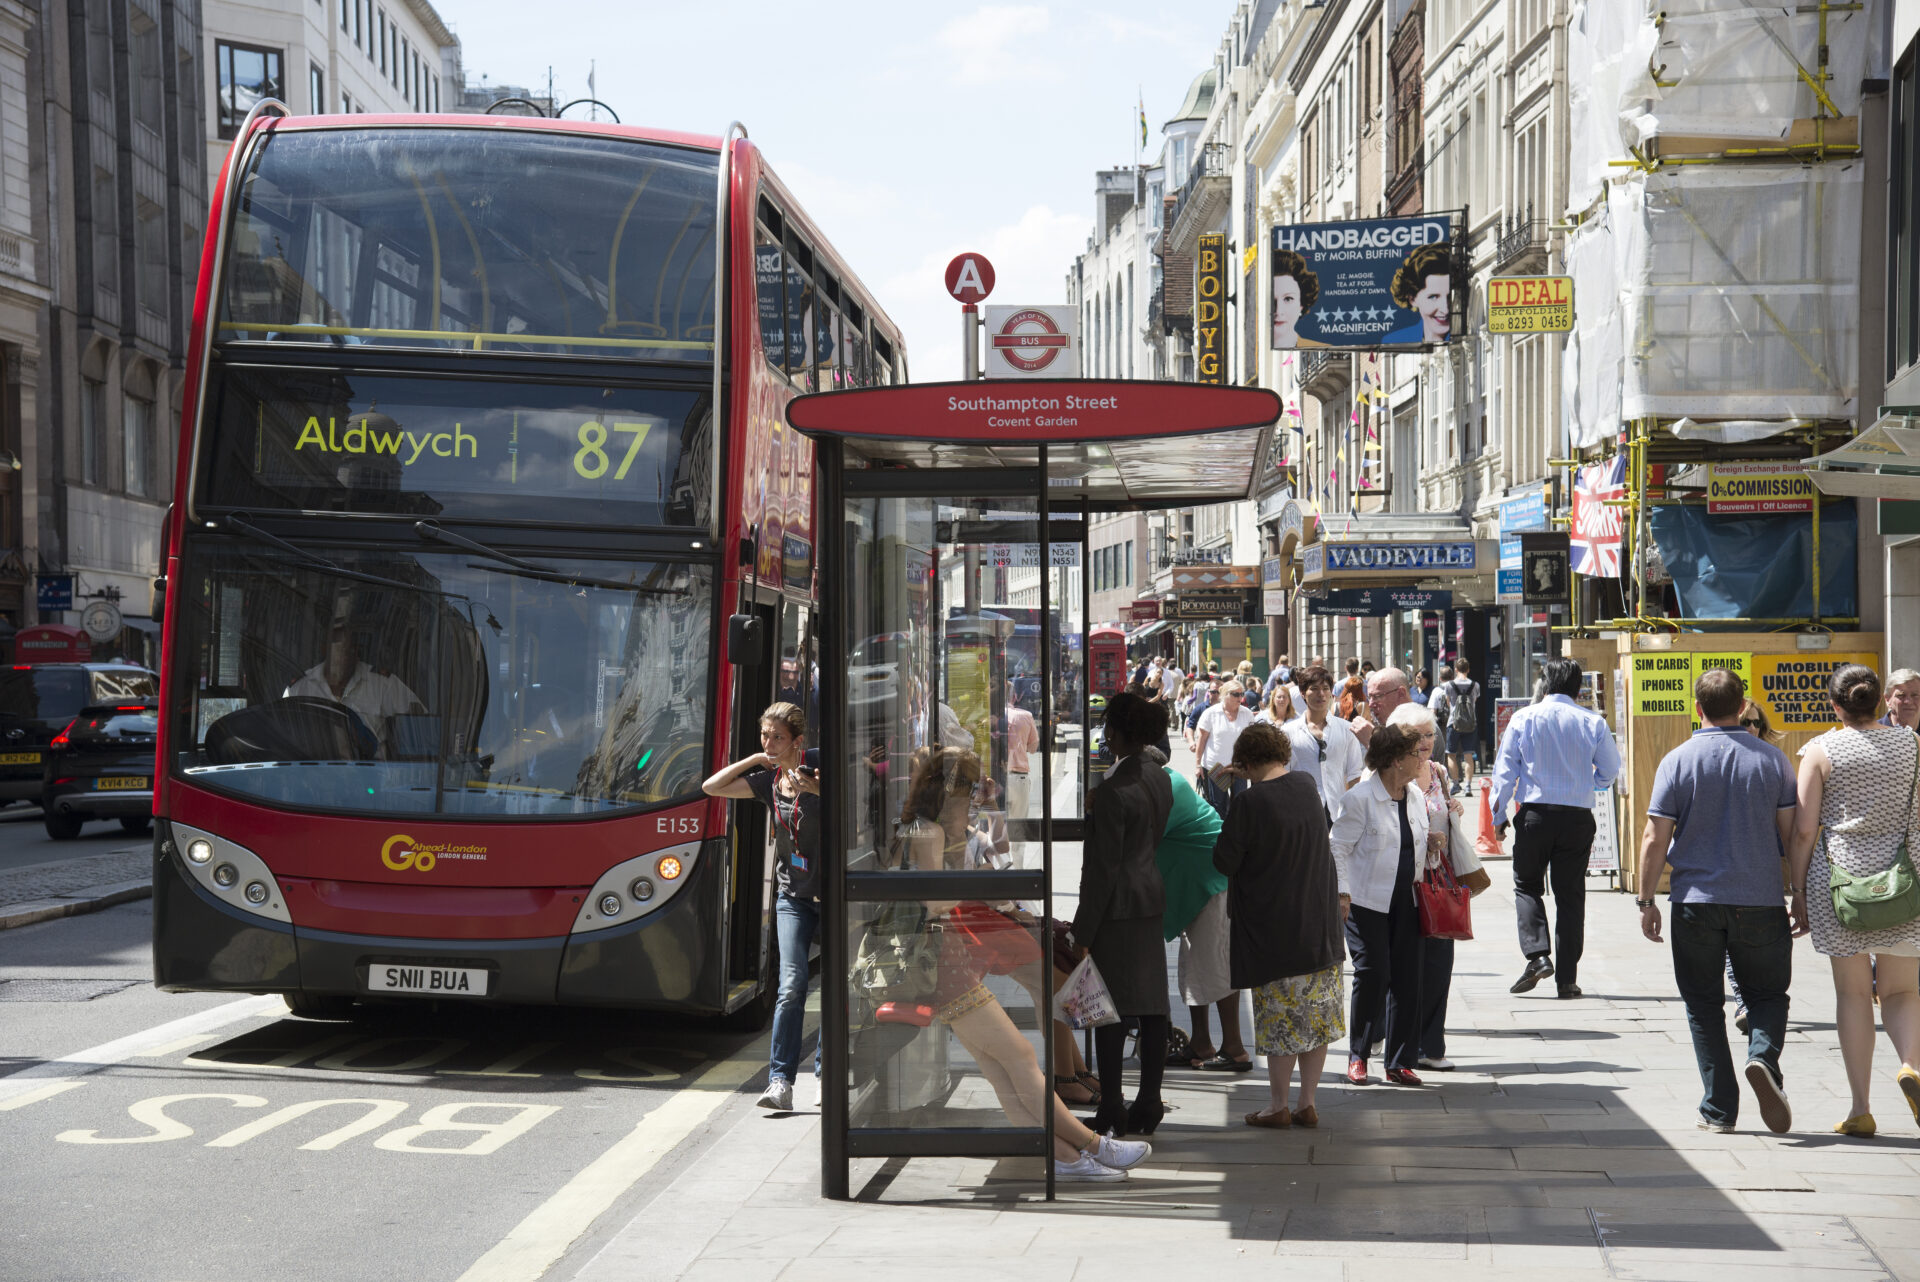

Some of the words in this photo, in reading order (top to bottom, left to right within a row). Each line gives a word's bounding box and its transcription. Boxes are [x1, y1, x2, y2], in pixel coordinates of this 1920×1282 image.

[1201, 238, 1220, 246] THE
[1277, 222, 1444, 251] HANDBAGGED
[1314, 252, 1327, 262] BY
[1329, 250, 1363, 261] MOIRA
[1365, 248, 1402, 259] BUFFINI
[953, 259, 986, 294] A
[1491, 279, 1568, 306] IDEAL
[1200, 250, 1219, 384] BODYG
[1491, 306, 1568, 316] SCAFFOLDING
[1507, 316, 1534, 329] 8293
[1541, 314, 1568, 328] 0456
[1021, 337, 1039, 345] BUS
[947, 395, 1059, 413] Southampton
[1065, 395, 1118, 410] Street
[988, 416, 1031, 427] Covent
[1034, 415, 1078, 427] Garden
[294, 415, 478, 466] Aldwych
[573, 420, 652, 480] 87
[1714, 464, 1742, 475] Foreign
[1744, 463, 1780, 474] Exchange
[1716, 503, 1755, 511] Souvenirs
[1762, 502, 1776, 510] Off
[1777, 502, 1808, 510] Licence
[993, 549, 1011, 557] N87
[1025, 549, 1041, 557] N9
[1052, 548, 1075, 556] N343
[1329, 547, 1473, 566] VAUDEVILLE
[1053, 557, 1075, 565] N551
[1181, 600, 1241, 611] BODYGUARD
[1635, 659, 1654, 671] SIM
[1656, 658, 1690, 670] CARDS
[1701, 658, 1743, 670] REPAIRS
[1642, 679, 1684, 691] iPHONES
[1642, 700, 1685, 712] MOBILES
[1774, 703, 1802, 713] SIM
[656, 817, 700, 834] E153
[381, 834, 436, 872] Go
[437, 852, 461, 860] LONDON
[462, 852, 487, 861] GENERAL
[385, 968, 424, 989] SN11
[429, 970, 470, 991] BUA
[55, 1093, 562, 1155] BUS
